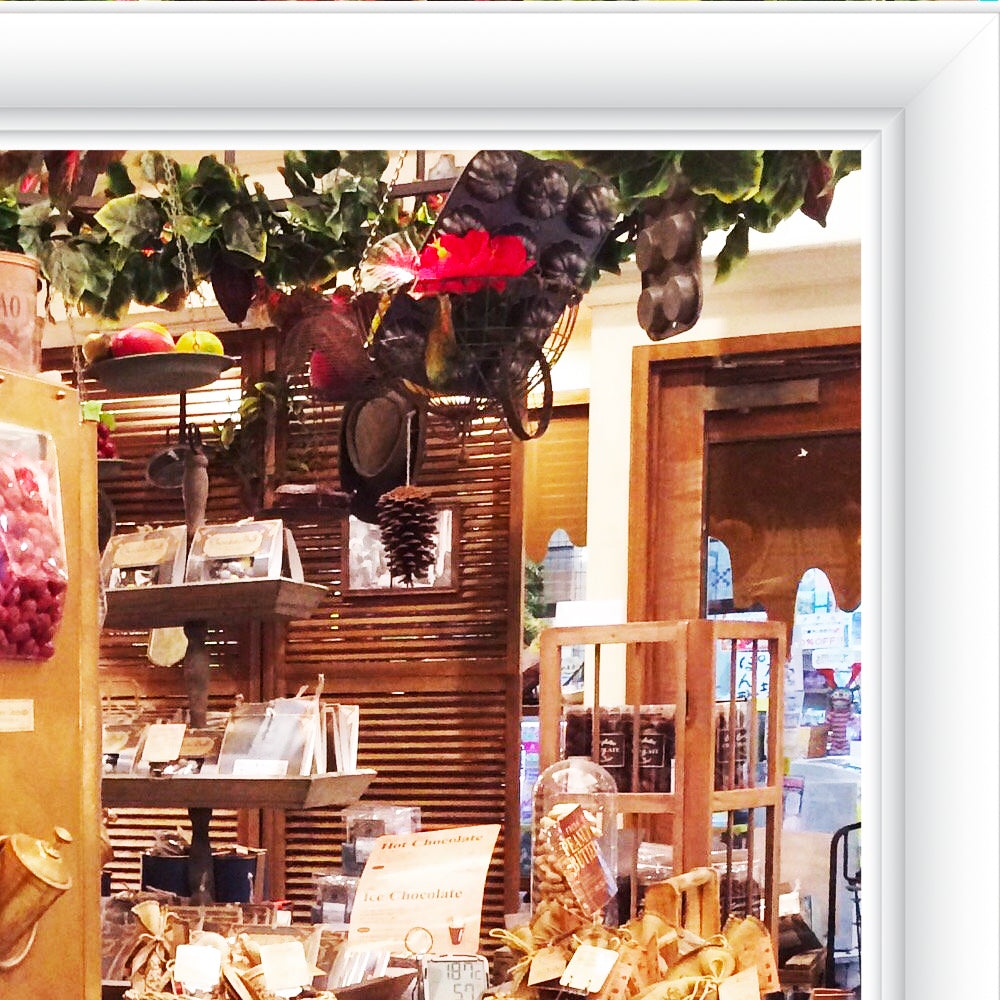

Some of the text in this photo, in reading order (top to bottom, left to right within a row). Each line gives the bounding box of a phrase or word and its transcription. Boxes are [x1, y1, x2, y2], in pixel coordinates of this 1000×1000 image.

[381, 834, 484, 850] Hot Chocolate
[363, 888, 463, 902] Ice Chocolate
